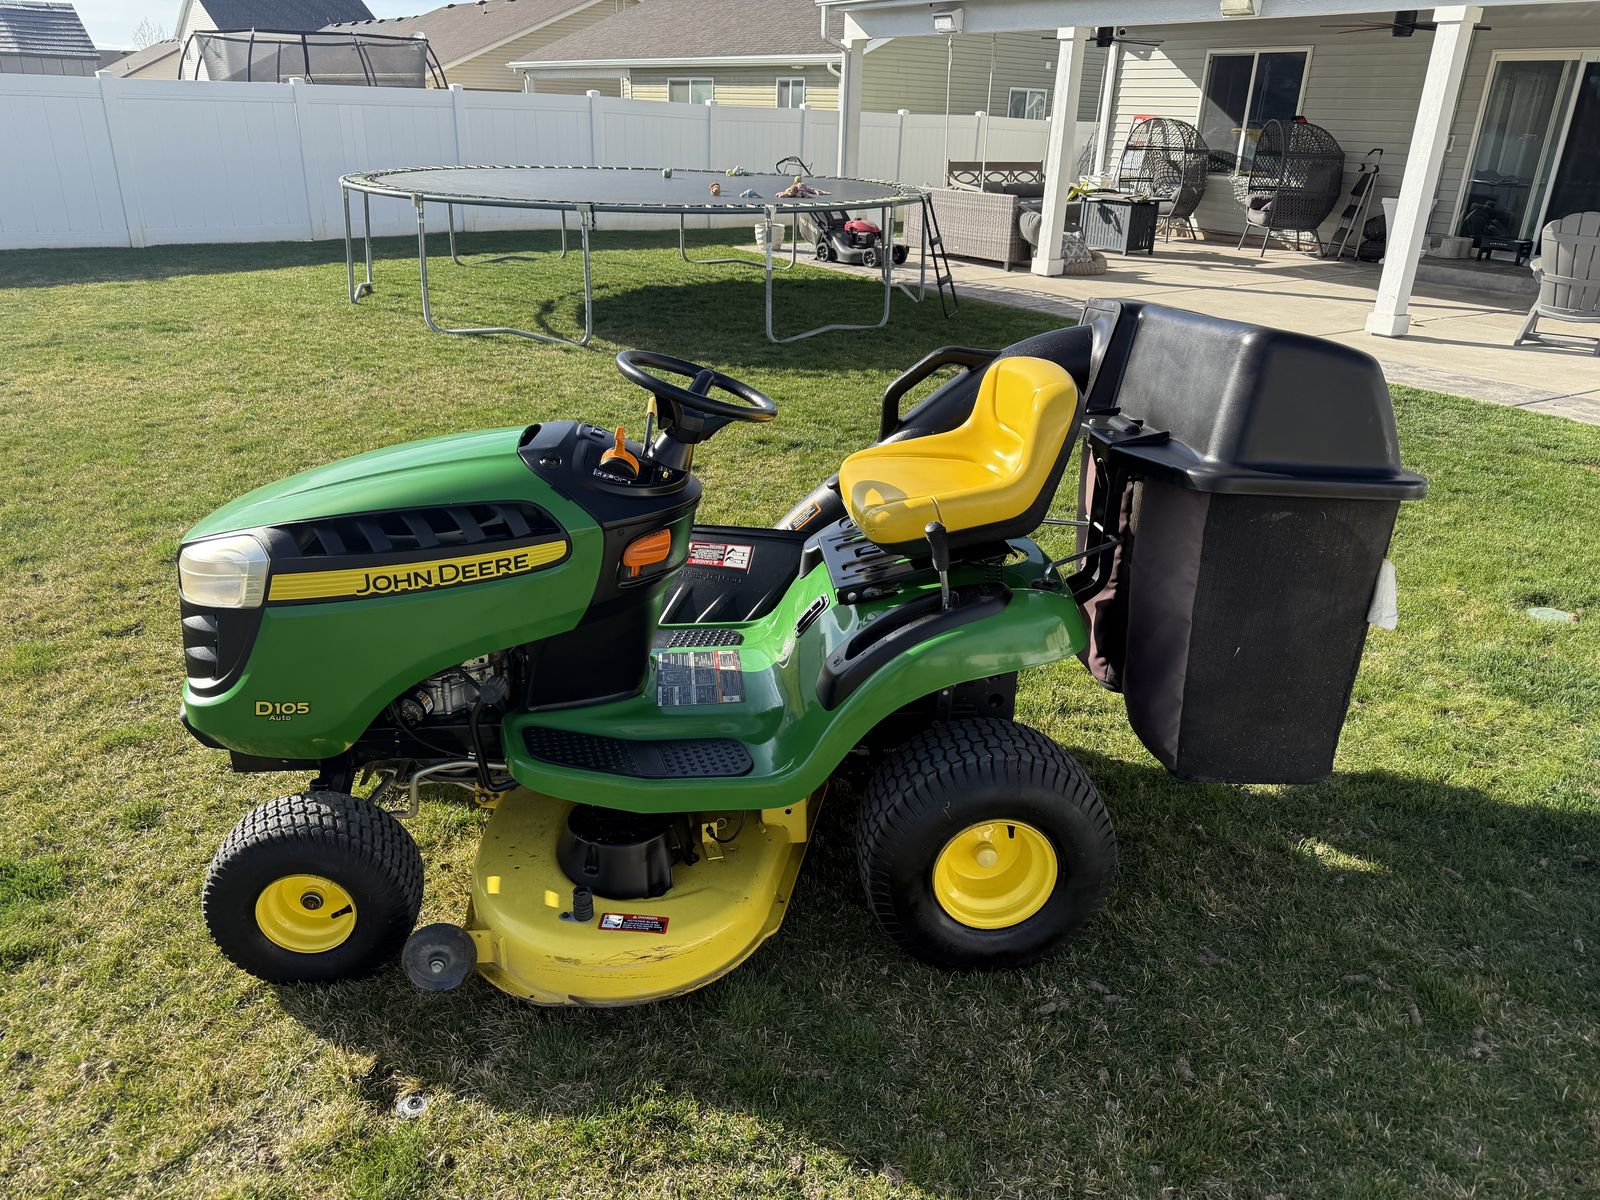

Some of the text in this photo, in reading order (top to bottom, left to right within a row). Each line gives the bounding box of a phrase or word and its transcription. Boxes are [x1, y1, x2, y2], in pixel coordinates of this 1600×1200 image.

[356, 553, 529, 594] JOHN DEERE
[255, 701, 310, 716] D105
